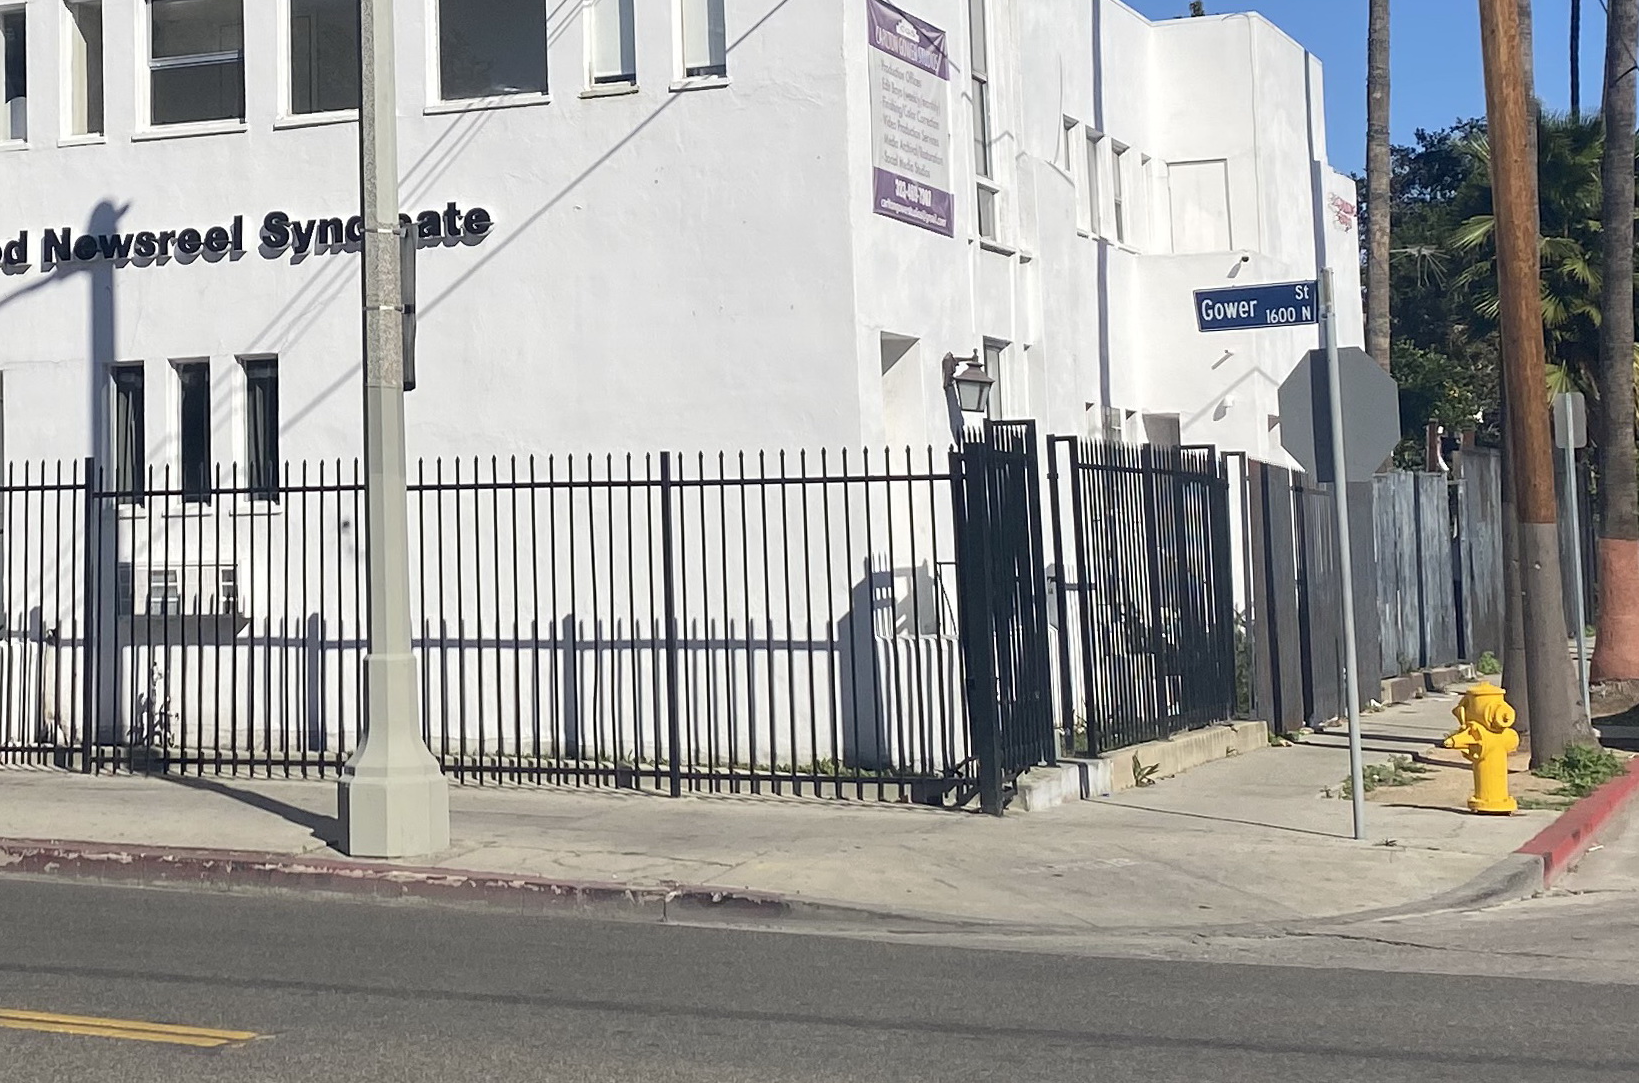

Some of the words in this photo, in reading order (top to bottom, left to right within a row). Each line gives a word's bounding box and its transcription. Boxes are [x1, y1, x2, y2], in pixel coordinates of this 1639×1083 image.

[44, 215, 243, 262] Newsreel
[262, 202, 491, 254] Synate
[1202, 299, 1257, 321] Gower
[1295, 285, 1309, 300] St
[1266, 307, 1296, 324] 1600
[1302, 306, 1311, 321] N
